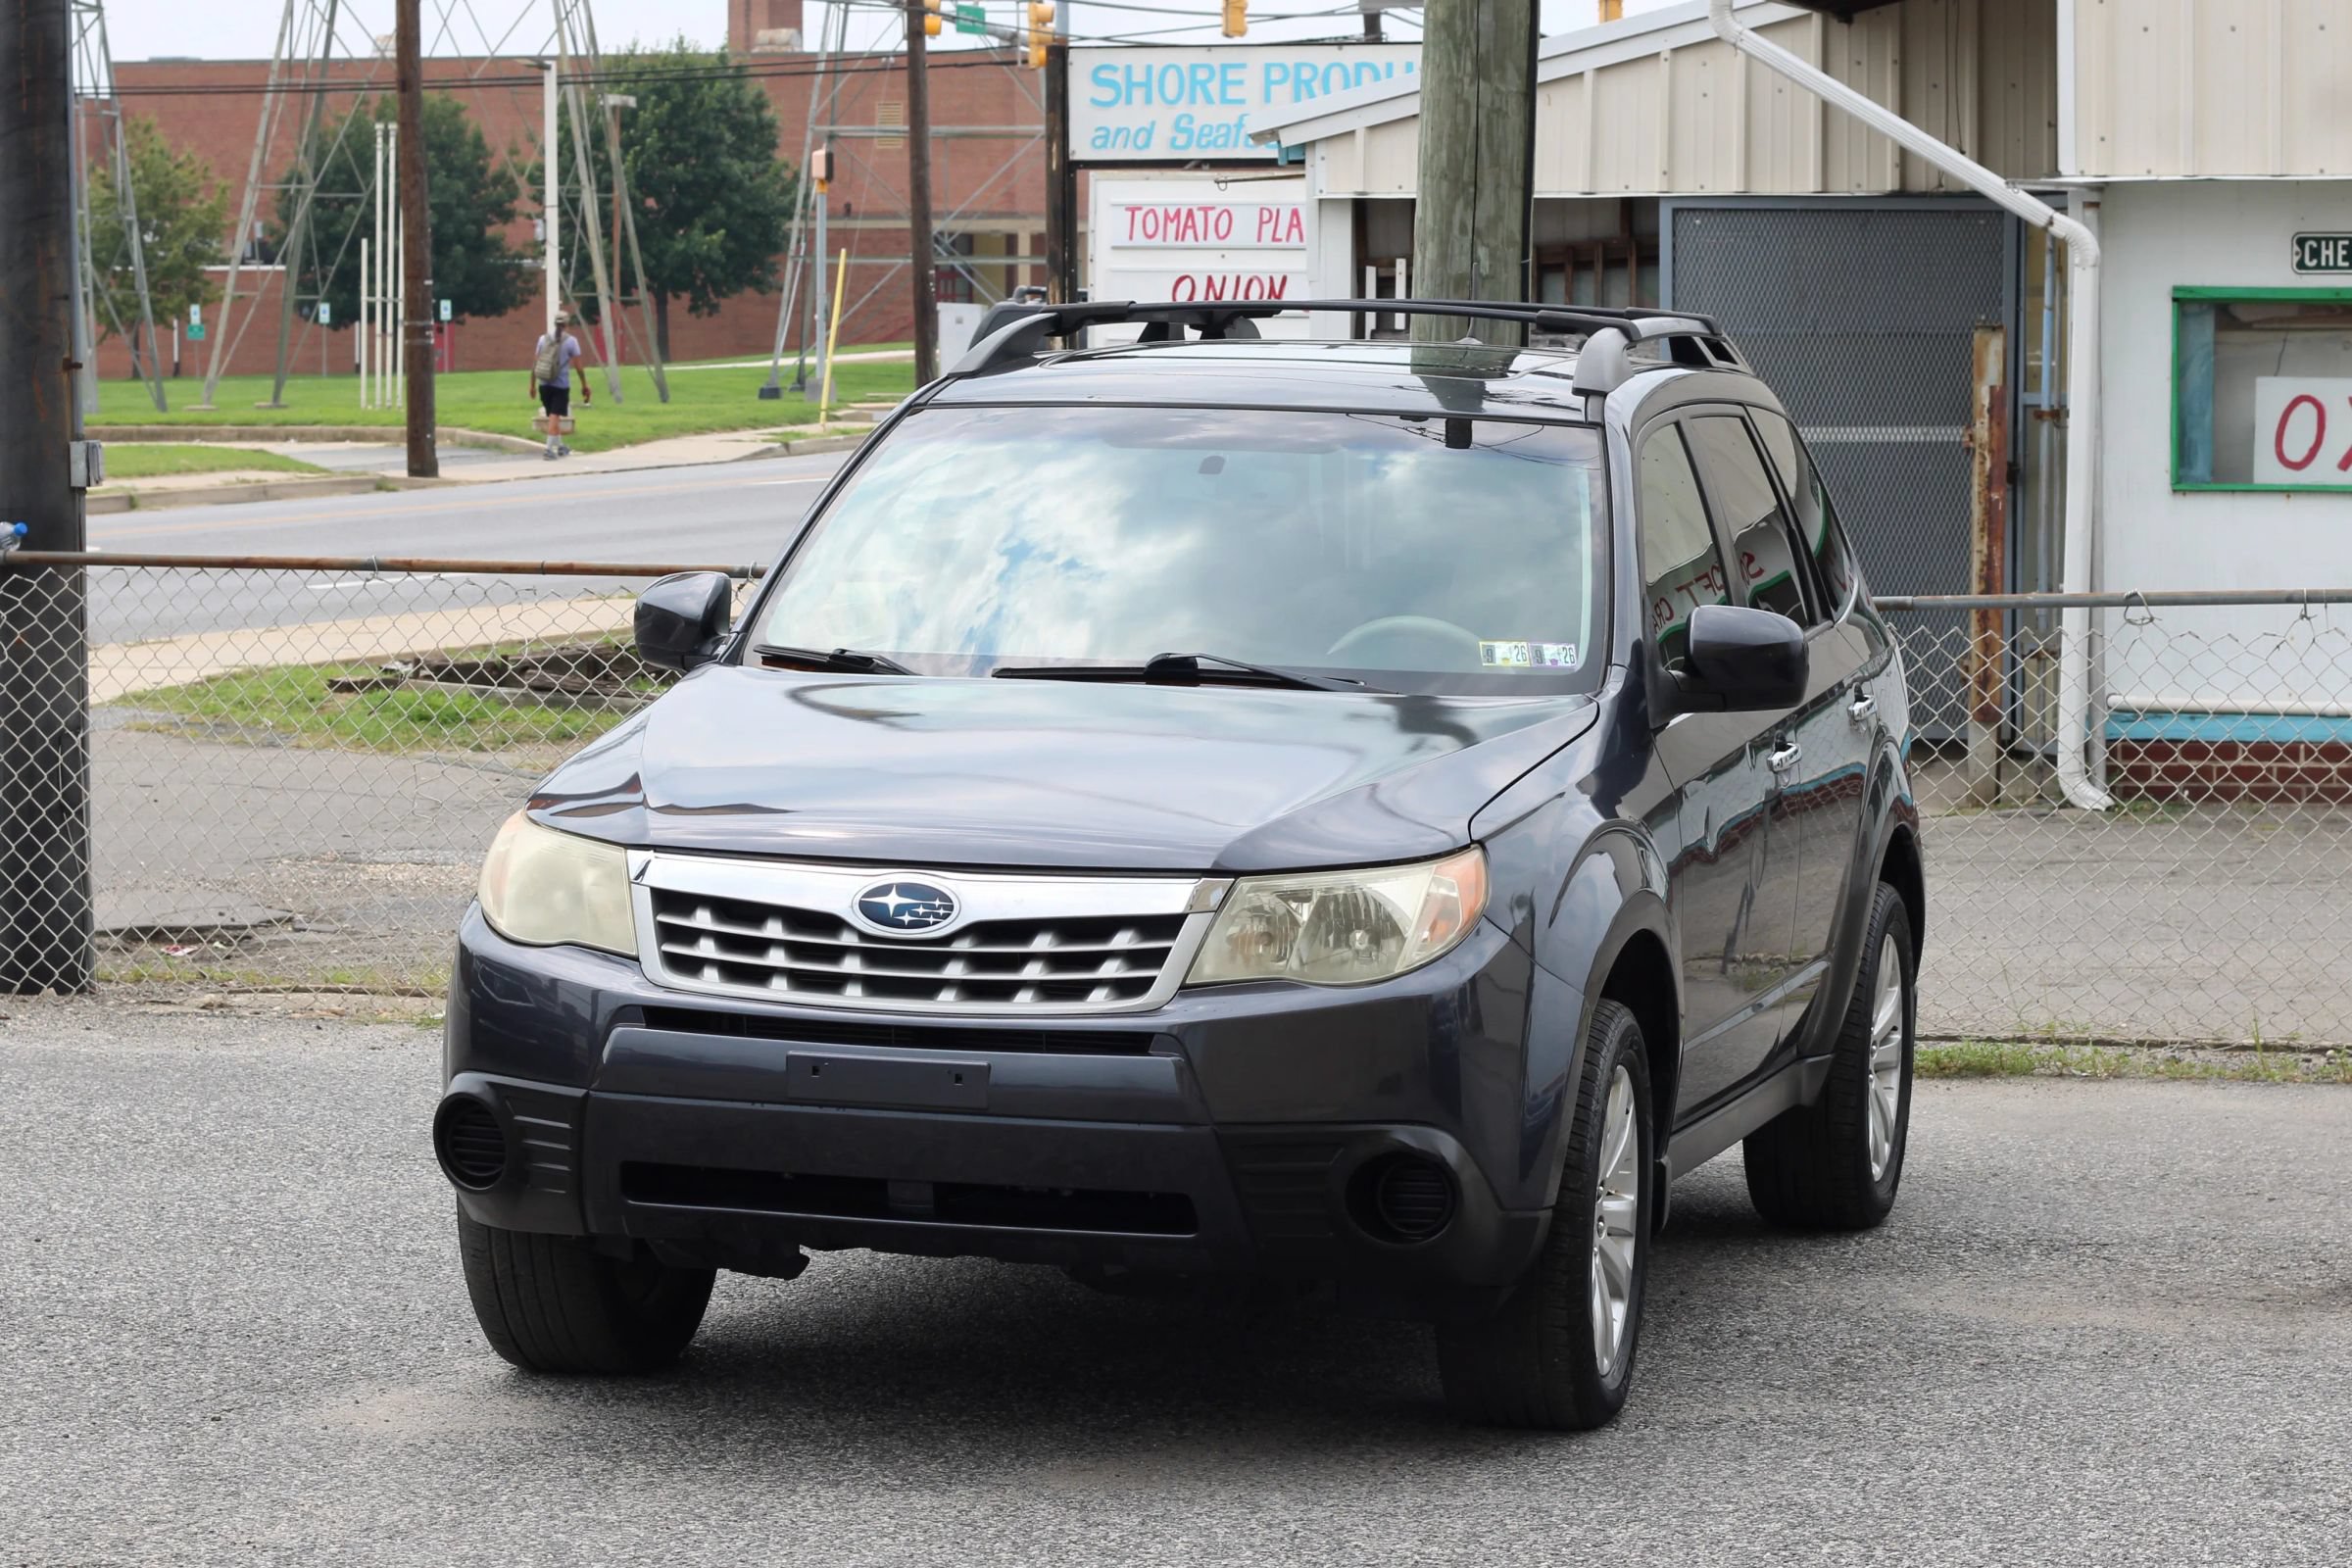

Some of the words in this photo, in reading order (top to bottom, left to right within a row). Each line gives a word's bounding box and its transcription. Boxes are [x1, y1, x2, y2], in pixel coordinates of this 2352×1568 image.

[1090, 62, 1248, 108] SHORE
[1091, 120, 1156, 151] and
[1124, 205, 1233, 242] TOMATO
[1256, 206, 1305, 244] PLA
[2304, 239, 2350, 268] CHE
[1171, 273, 1288, 303] ONION
[1514, 645, 1528, 662] 26
[1562, 647, 1576, 664] 26
